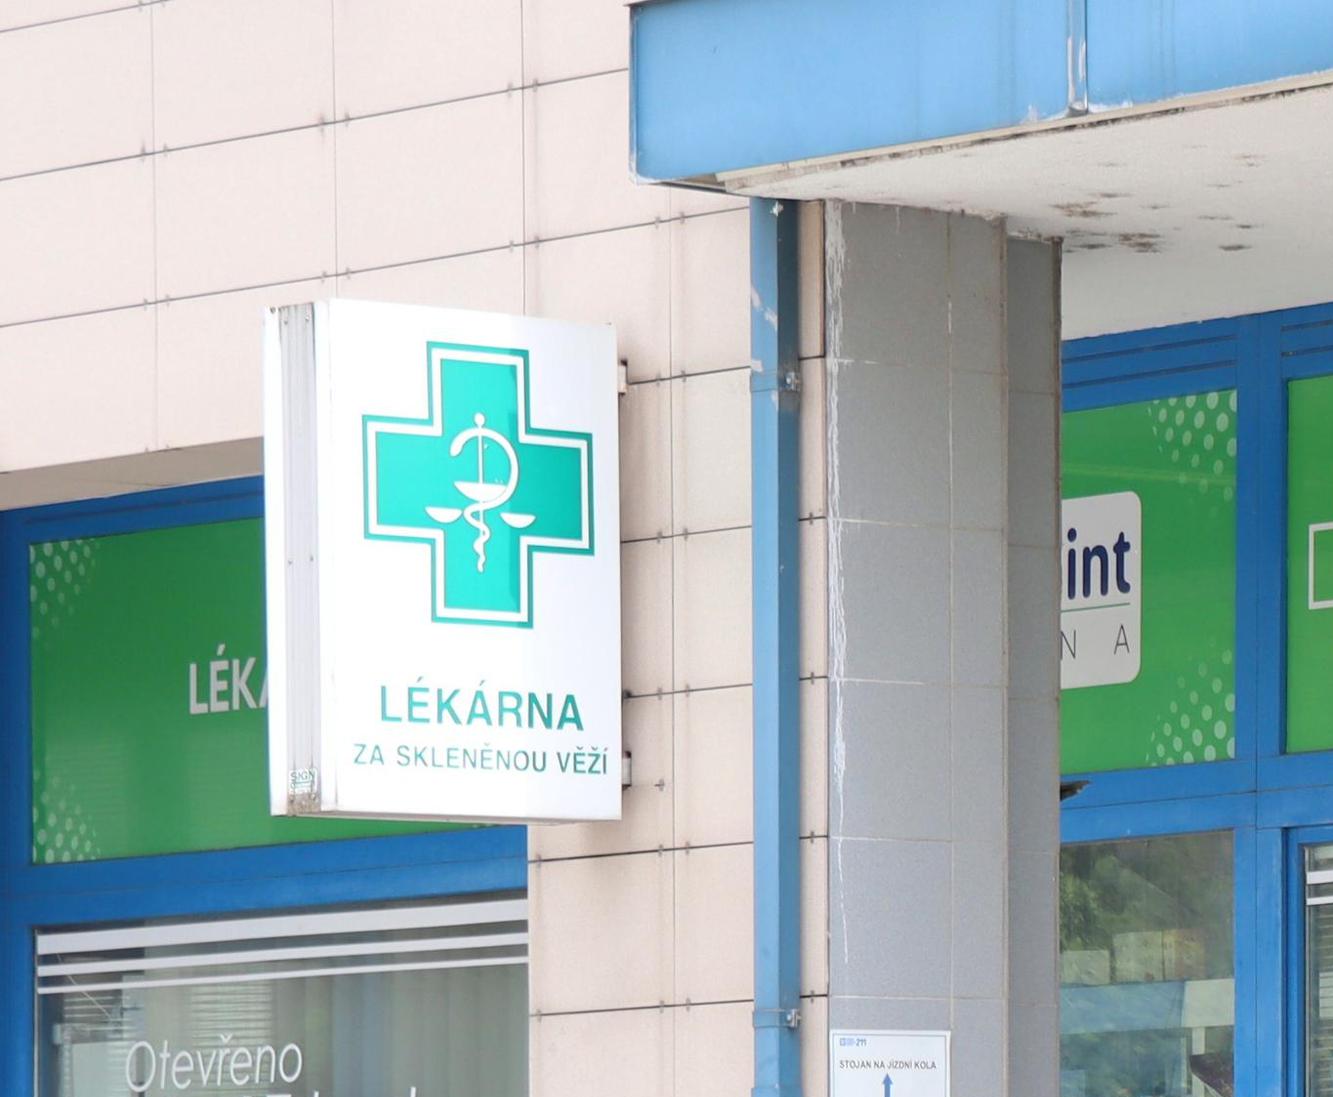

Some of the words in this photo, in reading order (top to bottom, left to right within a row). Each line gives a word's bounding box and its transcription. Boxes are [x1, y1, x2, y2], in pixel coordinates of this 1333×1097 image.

[190, 643, 268, 714] LÉK
[380, 676, 584, 731] LÉKÁRNA
[353, 744, 385, 765] ZA
[396, 742, 547, 773] SKLENĚNOU
[556, 746, 608, 775] VĚŽÍ
[125, 1033, 303, 1092] Otevřeno
[839, 1060, 872, 1069] STOJAN
[873, 1060, 885, 1069] NA
[887, 1059, 913, 1070] JÍZDNÍ
[915, 1060, 937, 1069] KOLA
